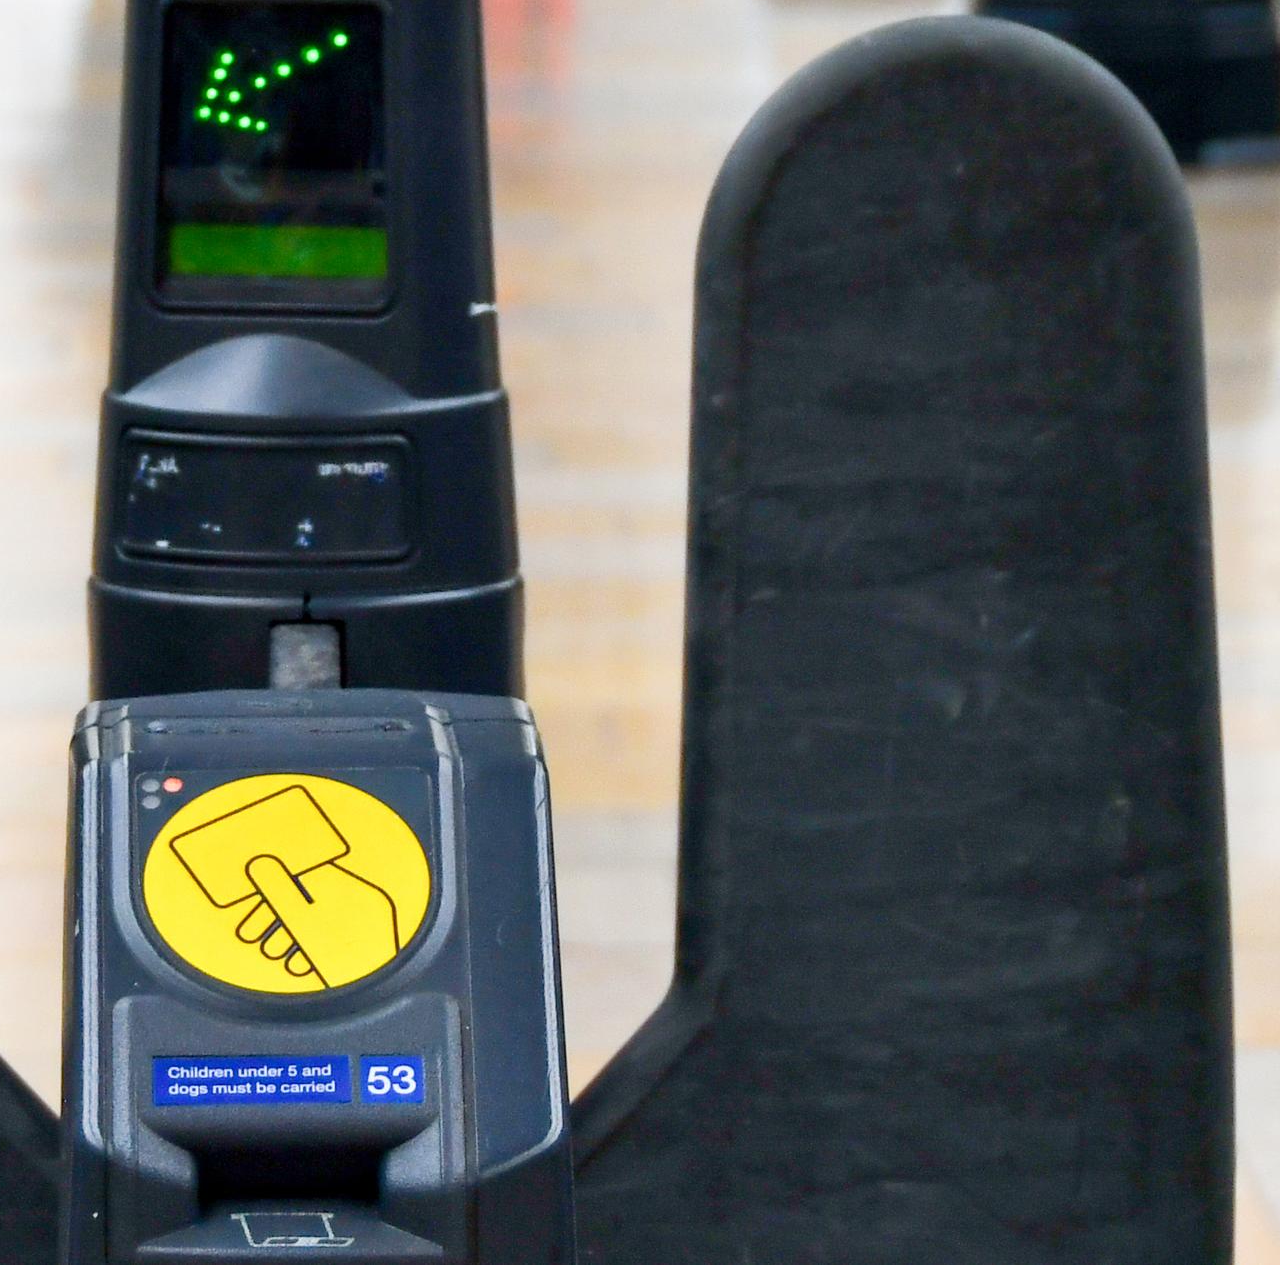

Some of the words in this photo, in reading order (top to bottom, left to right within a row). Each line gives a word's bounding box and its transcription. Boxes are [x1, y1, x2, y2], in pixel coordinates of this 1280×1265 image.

[168, 1067, 233, 1078] Children
[238, 1066, 283, 1077] under
[288, 1065, 297, 1077] 5
[302, 1064, 332, 1077] and
[169, 1083, 208, 1096] dogs
[213, 1082, 251, 1094] must
[256, 1082, 276, 1093] be
[281, 1080, 335, 1093] carried
[367, 1065, 417, 1095] 53
